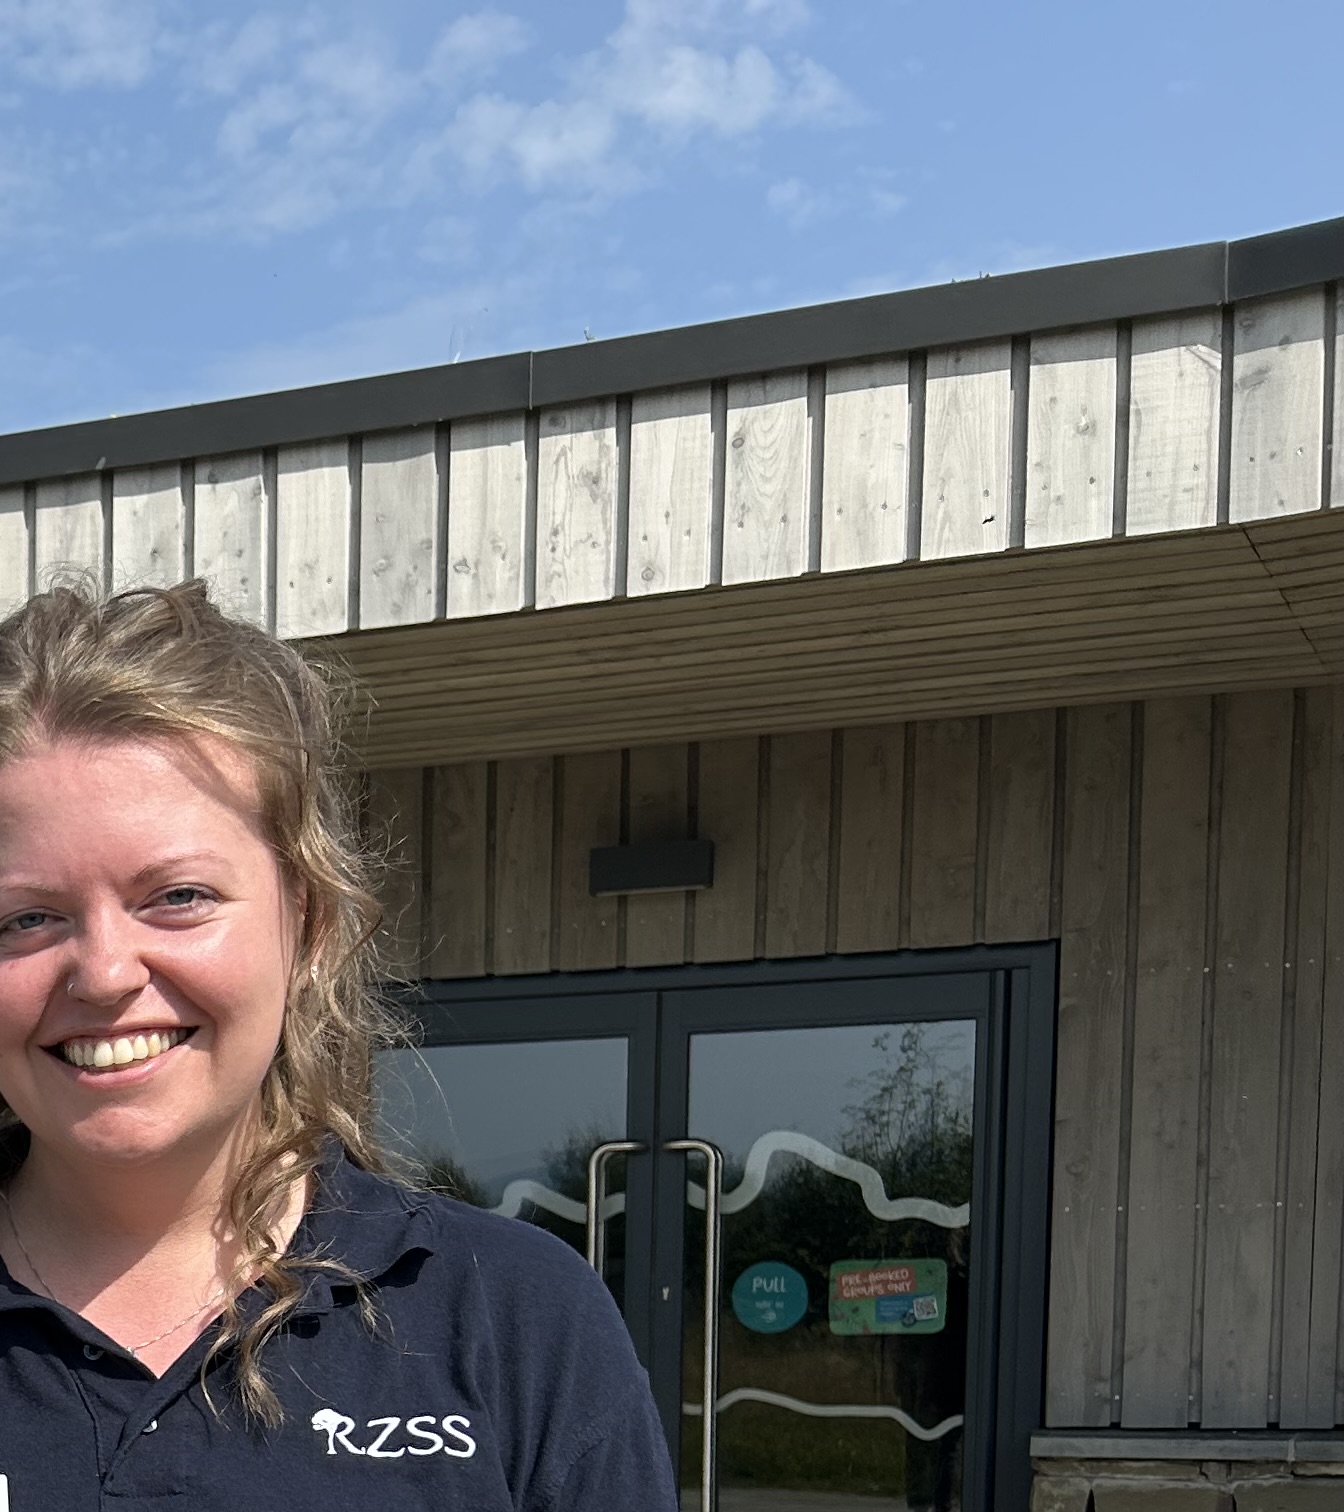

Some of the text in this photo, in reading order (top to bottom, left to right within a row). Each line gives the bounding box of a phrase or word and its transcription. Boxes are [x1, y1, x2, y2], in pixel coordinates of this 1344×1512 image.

[752, 1276, 787, 1293] PULL
[843, 1282, 912, 1298] GROUPS ONLY
[311, 1408, 477, 1458] RZSS
